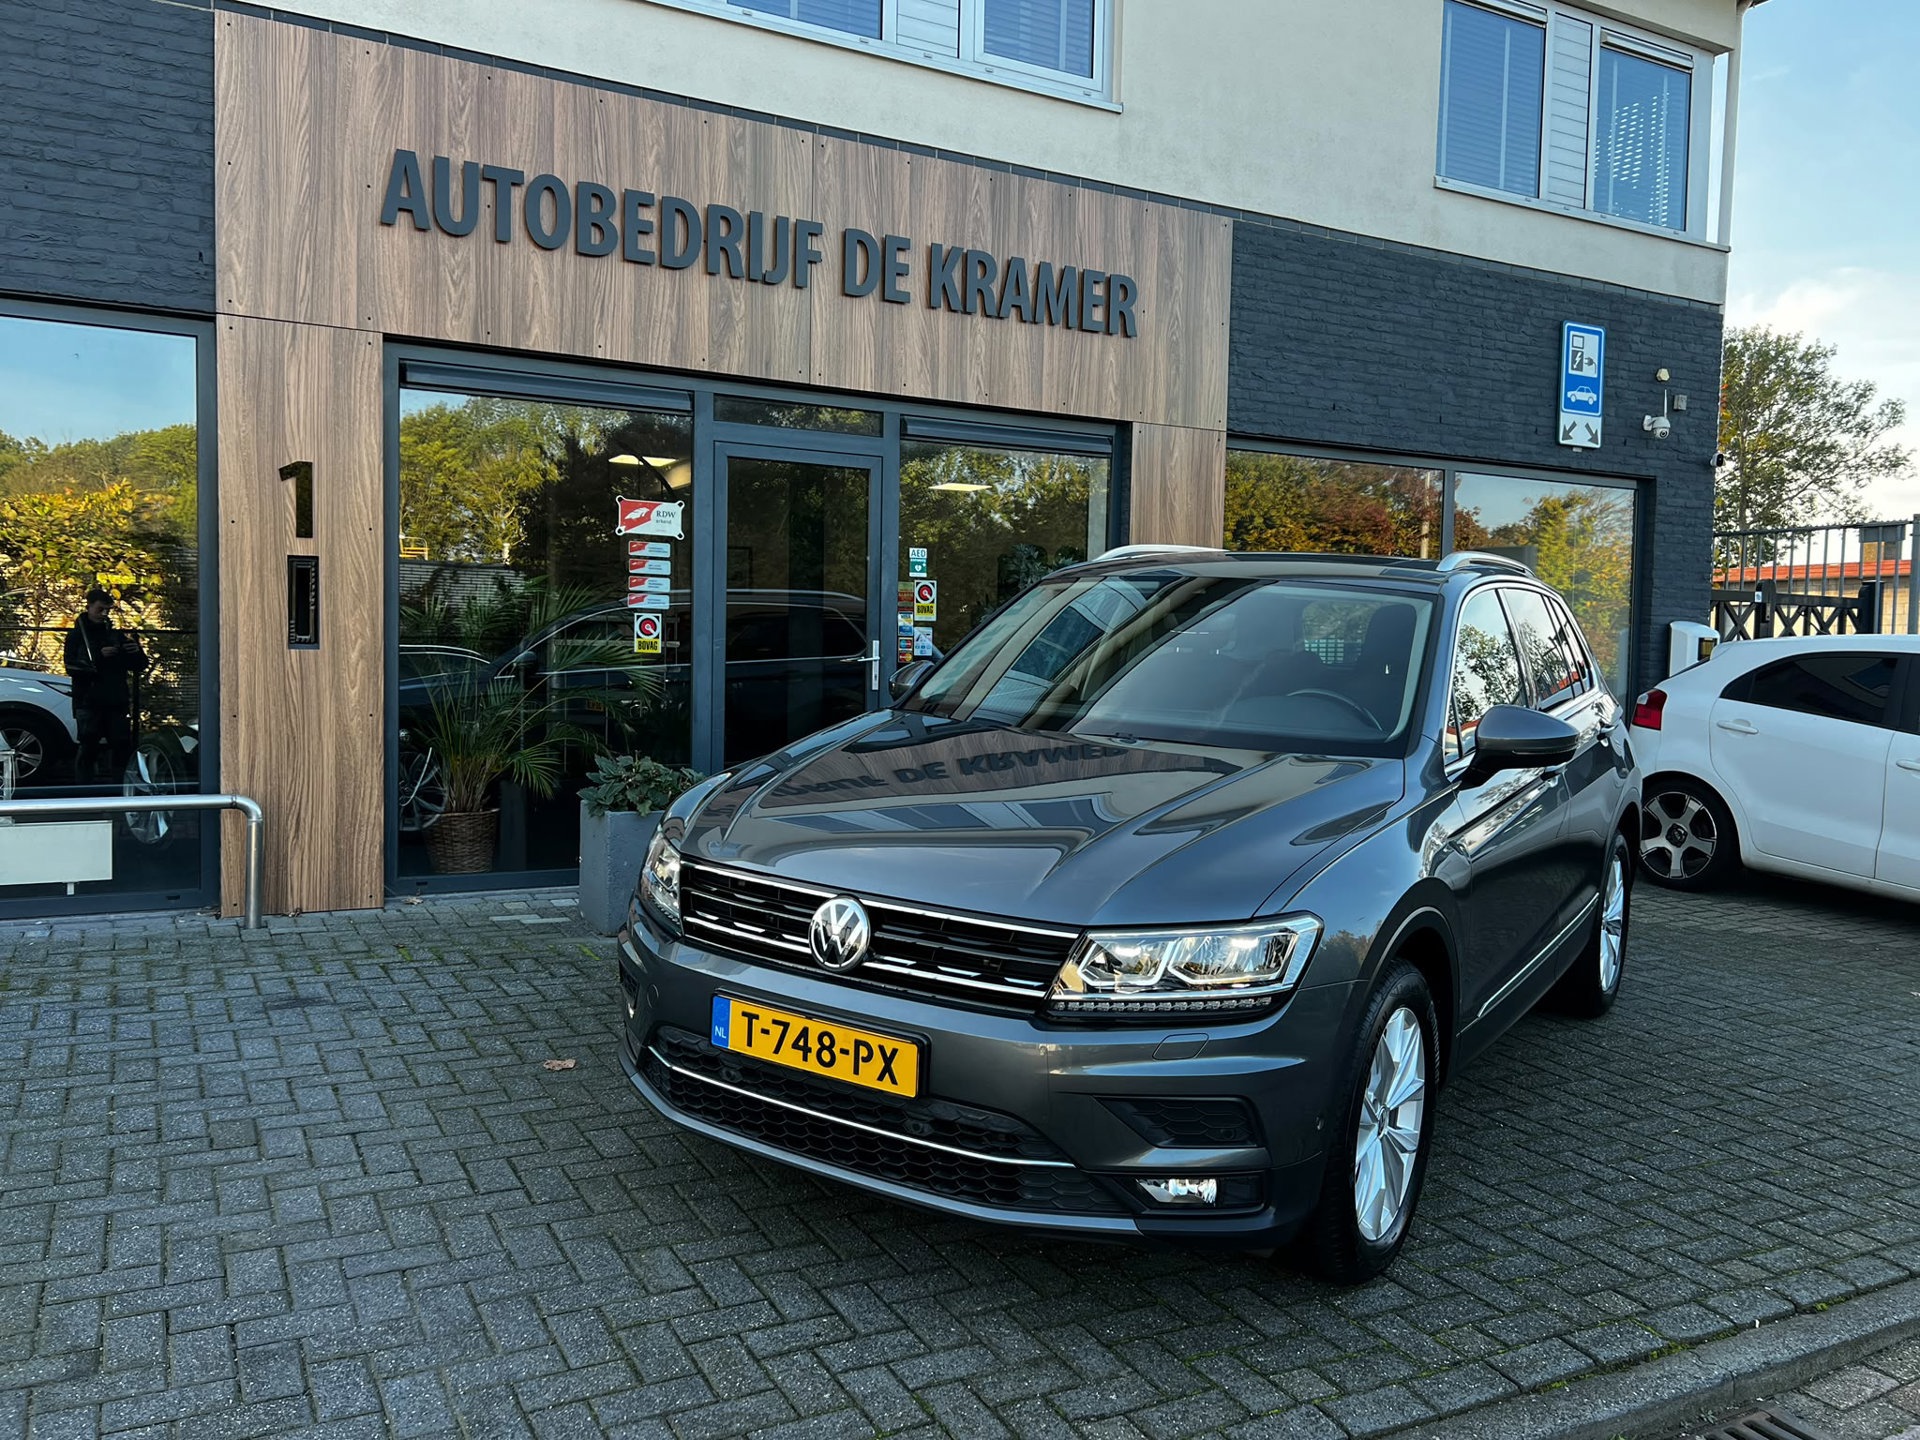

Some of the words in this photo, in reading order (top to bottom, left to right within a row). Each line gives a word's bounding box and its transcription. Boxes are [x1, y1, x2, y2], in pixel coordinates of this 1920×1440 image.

[381, 148, 822, 289] AUTOBEDRIJF
[843, 228, 911, 304] DE
[930, 242, 1138, 337] KRAMER
[279, 461, 313, 538] 1
[656, 510, 676, 518] RDW
[911, 549, 926, 557] AED
[917, 605, 934, 614] BOVAG
[638, 641, 658, 650] BOVAG
[714, 1025, 726, 1039] NL
[741, 1011, 899, 1086] T-748-PX
